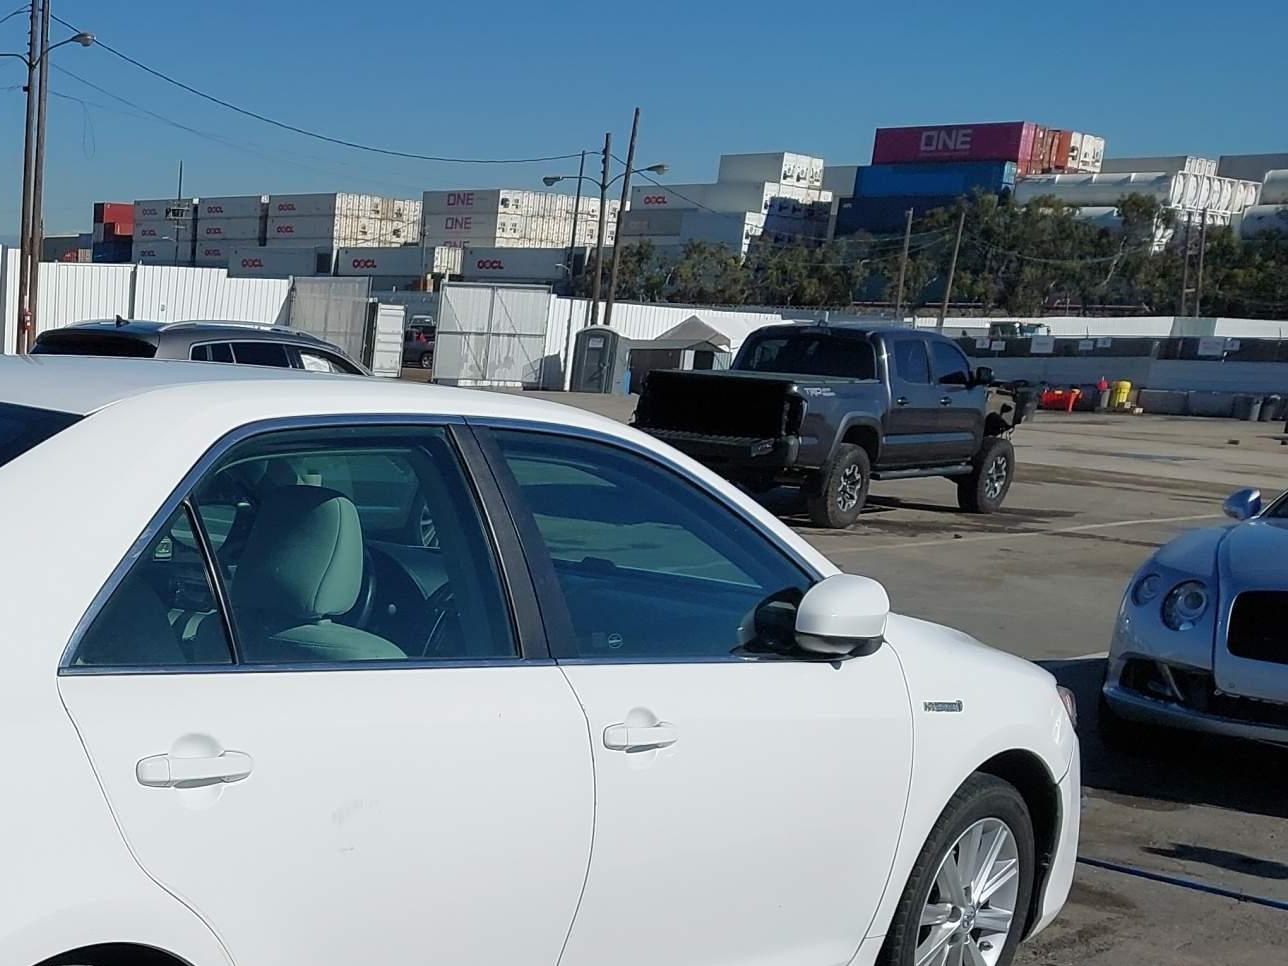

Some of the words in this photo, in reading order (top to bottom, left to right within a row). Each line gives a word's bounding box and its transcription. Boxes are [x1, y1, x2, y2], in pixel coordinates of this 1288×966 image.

[920, 129, 973, 151] ONE
[447, 192, 474, 207] ONE
[644, 196, 667, 205] OOCL
[445, 216, 472, 230] ONE
[241, 258, 264, 268] OOCL
[352, 258, 377, 268] OOCL
[477, 259, 504, 270] OOCL
